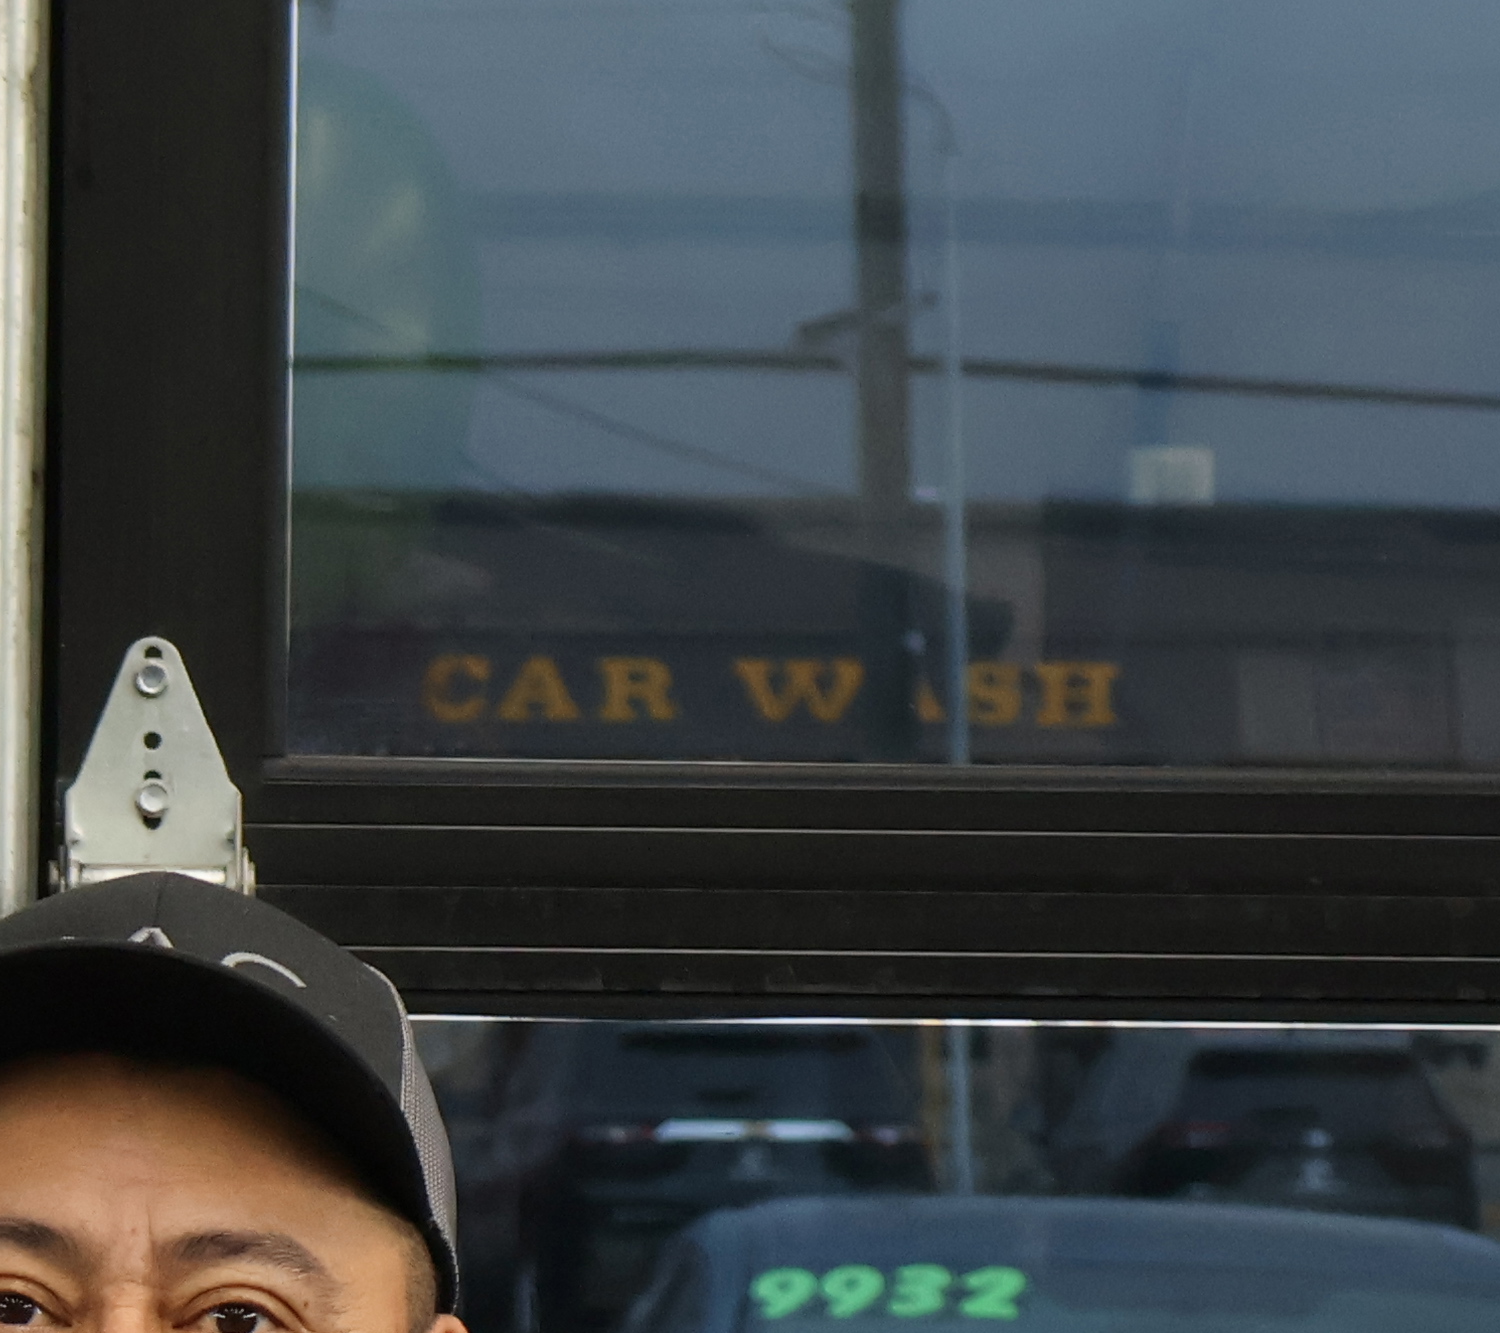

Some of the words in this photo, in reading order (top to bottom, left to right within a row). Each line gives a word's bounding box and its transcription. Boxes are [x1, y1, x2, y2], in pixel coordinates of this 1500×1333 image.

[420, 653, 678, 724] CAR
[733, 655, 1120, 728] WSH
[750, 1263, 1028, 1321] 9932
